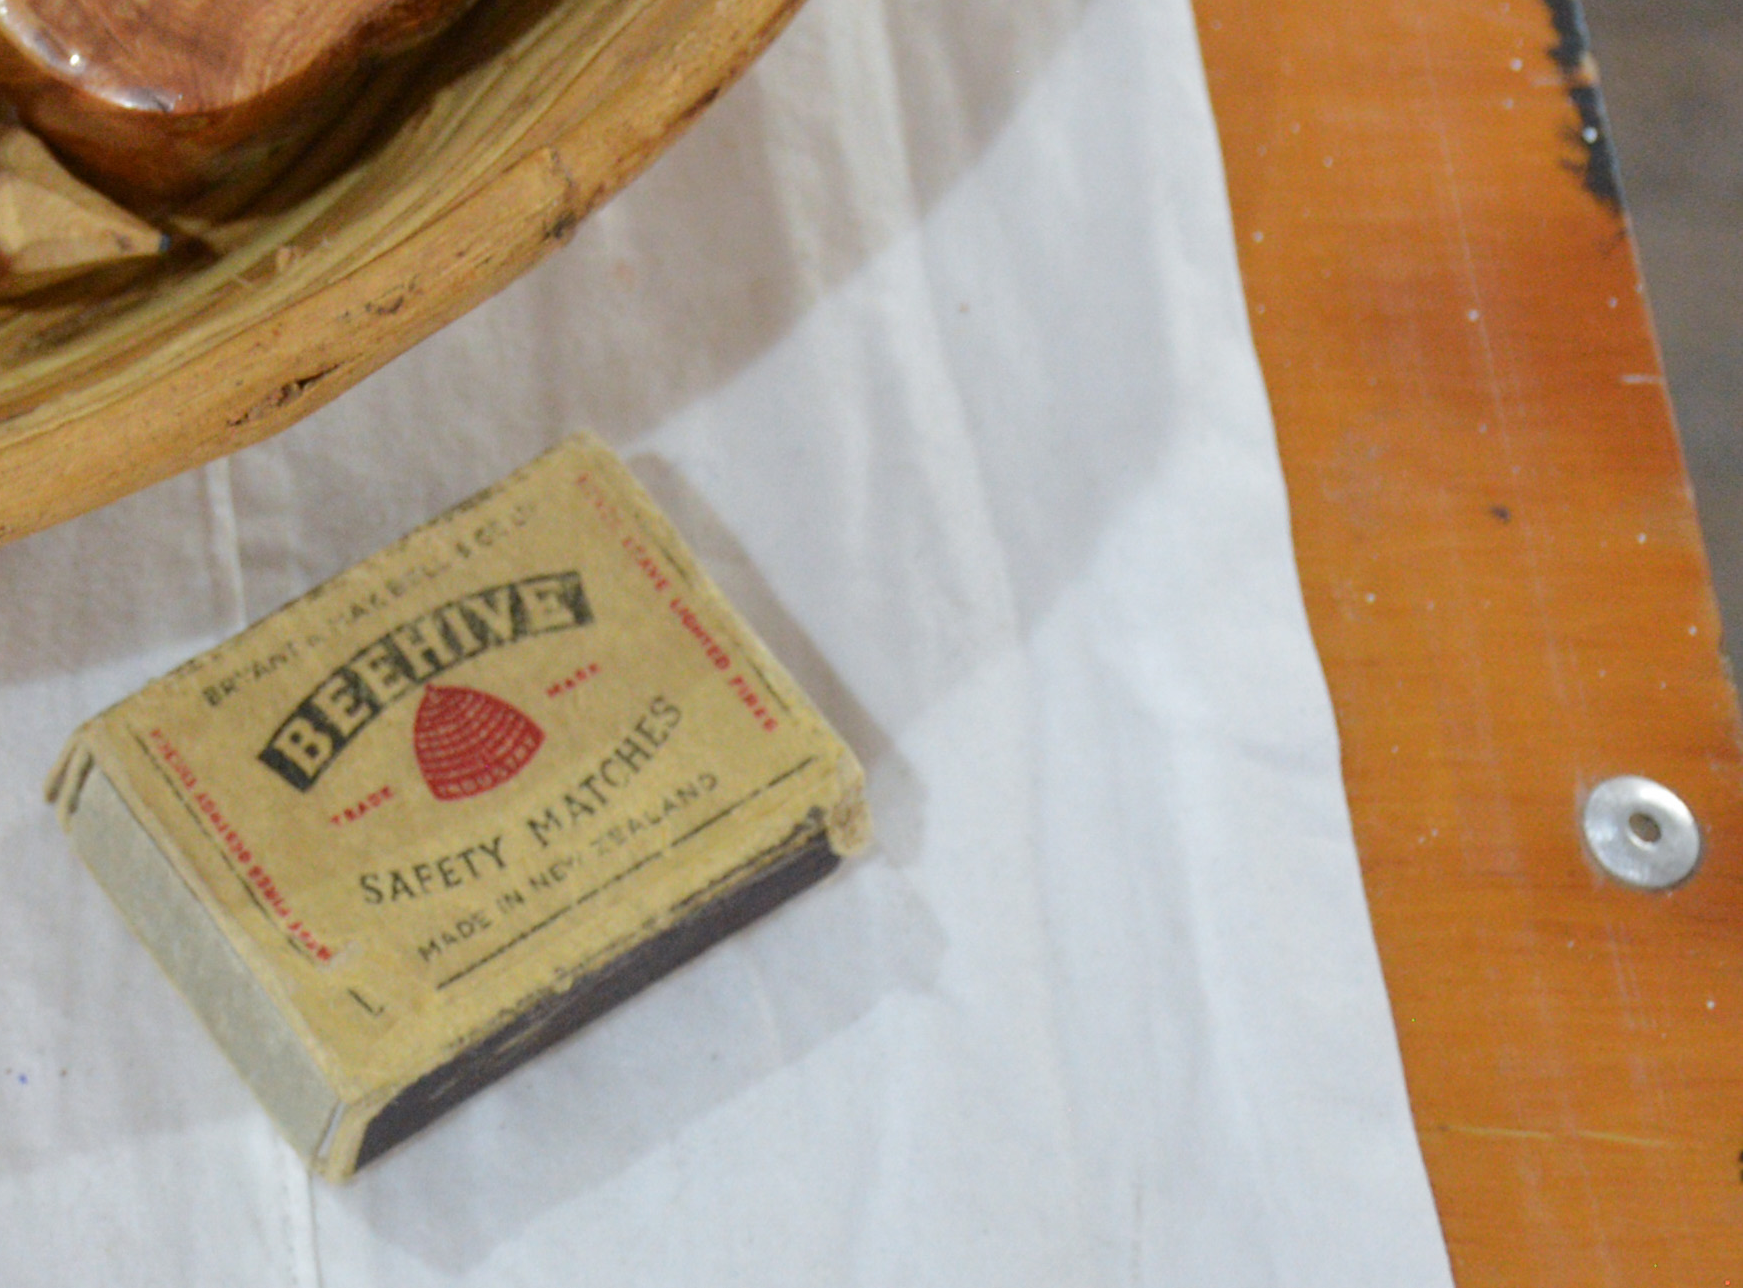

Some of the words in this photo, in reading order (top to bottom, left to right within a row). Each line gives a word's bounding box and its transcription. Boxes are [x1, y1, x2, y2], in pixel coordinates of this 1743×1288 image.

[264, 575, 582, 783] BEEHIVE
[330, 784, 394, 825] TRADE
[359, 835, 508, 906] SAFETY
[526, 693, 683, 848] MATCHES
[417, 912, 491, 963] MADE
[497, 888, 526, 915] IN
[590, 771, 720, 856] ZEALAND
